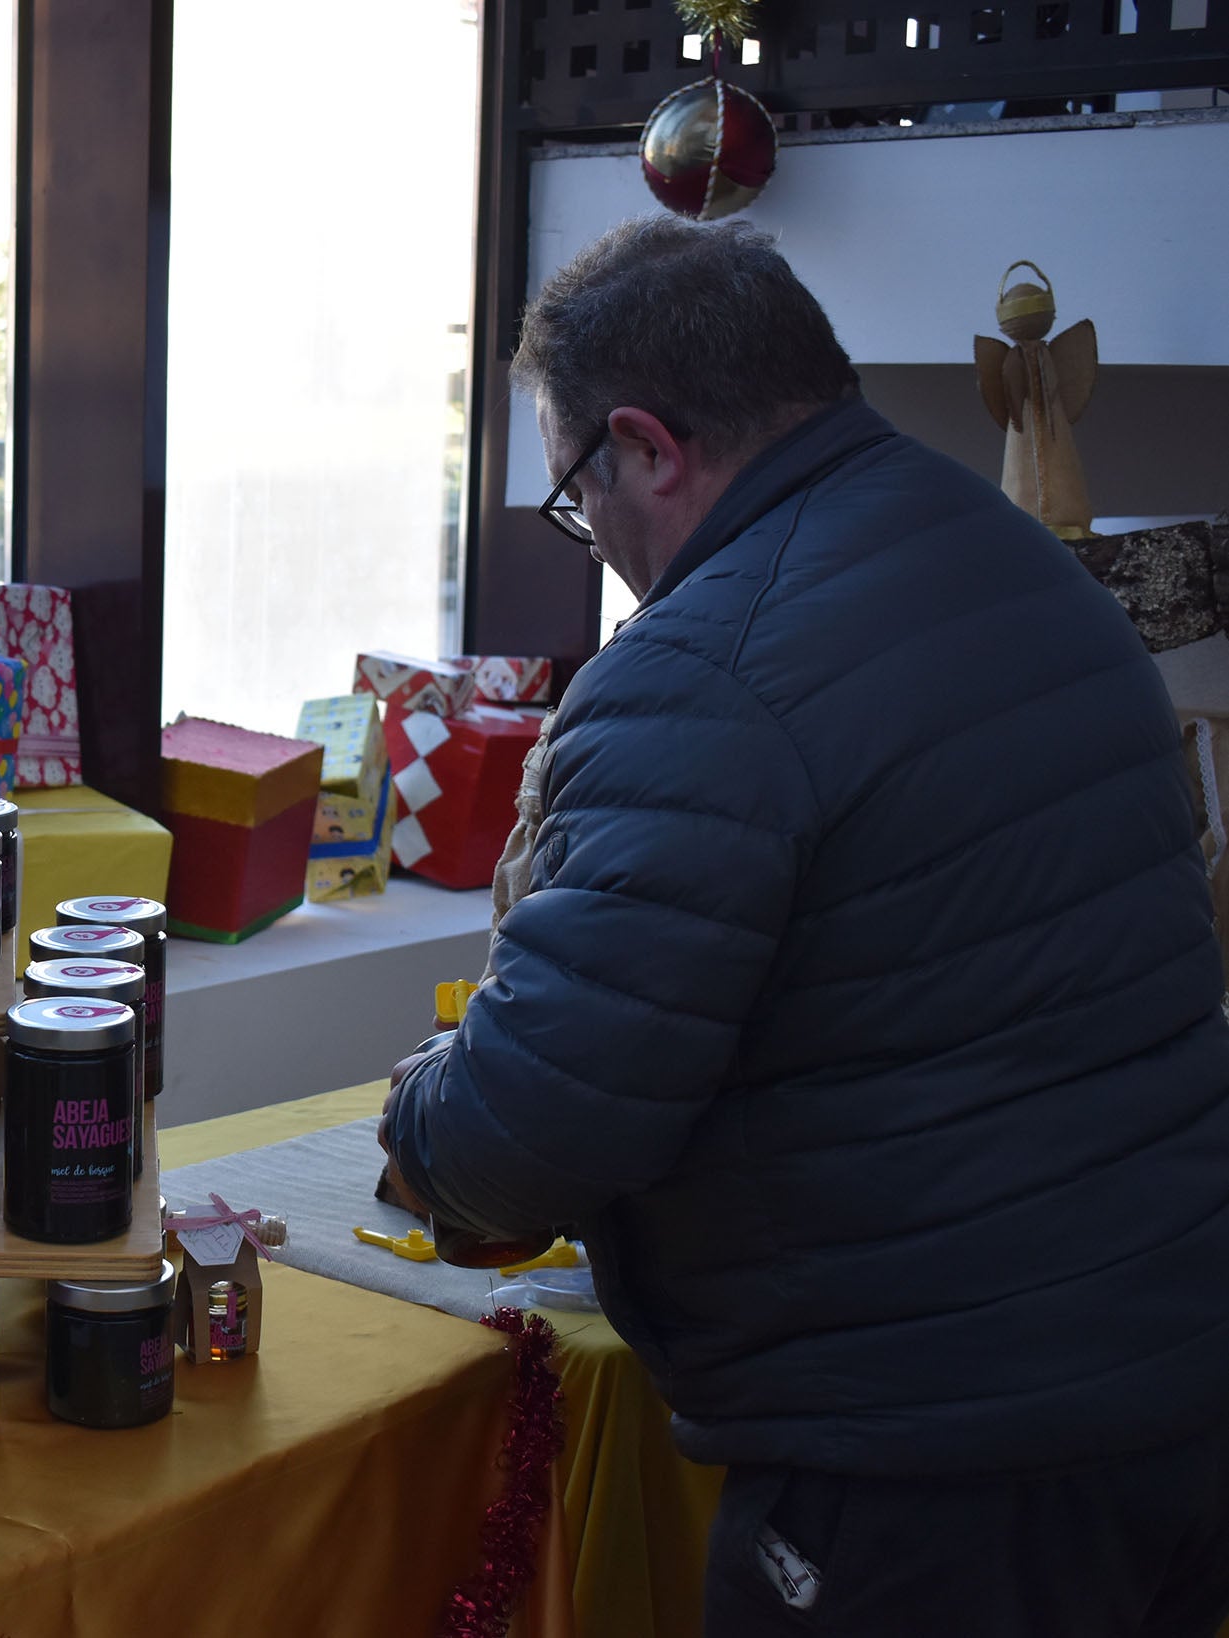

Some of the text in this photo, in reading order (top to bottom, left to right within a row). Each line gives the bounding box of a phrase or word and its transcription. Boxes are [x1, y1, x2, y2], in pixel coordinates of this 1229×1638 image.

[52, 1097, 110, 1126] ABEJA
[51, 1165, 71, 1177] miel
[73, 1163, 86, 1177] de
